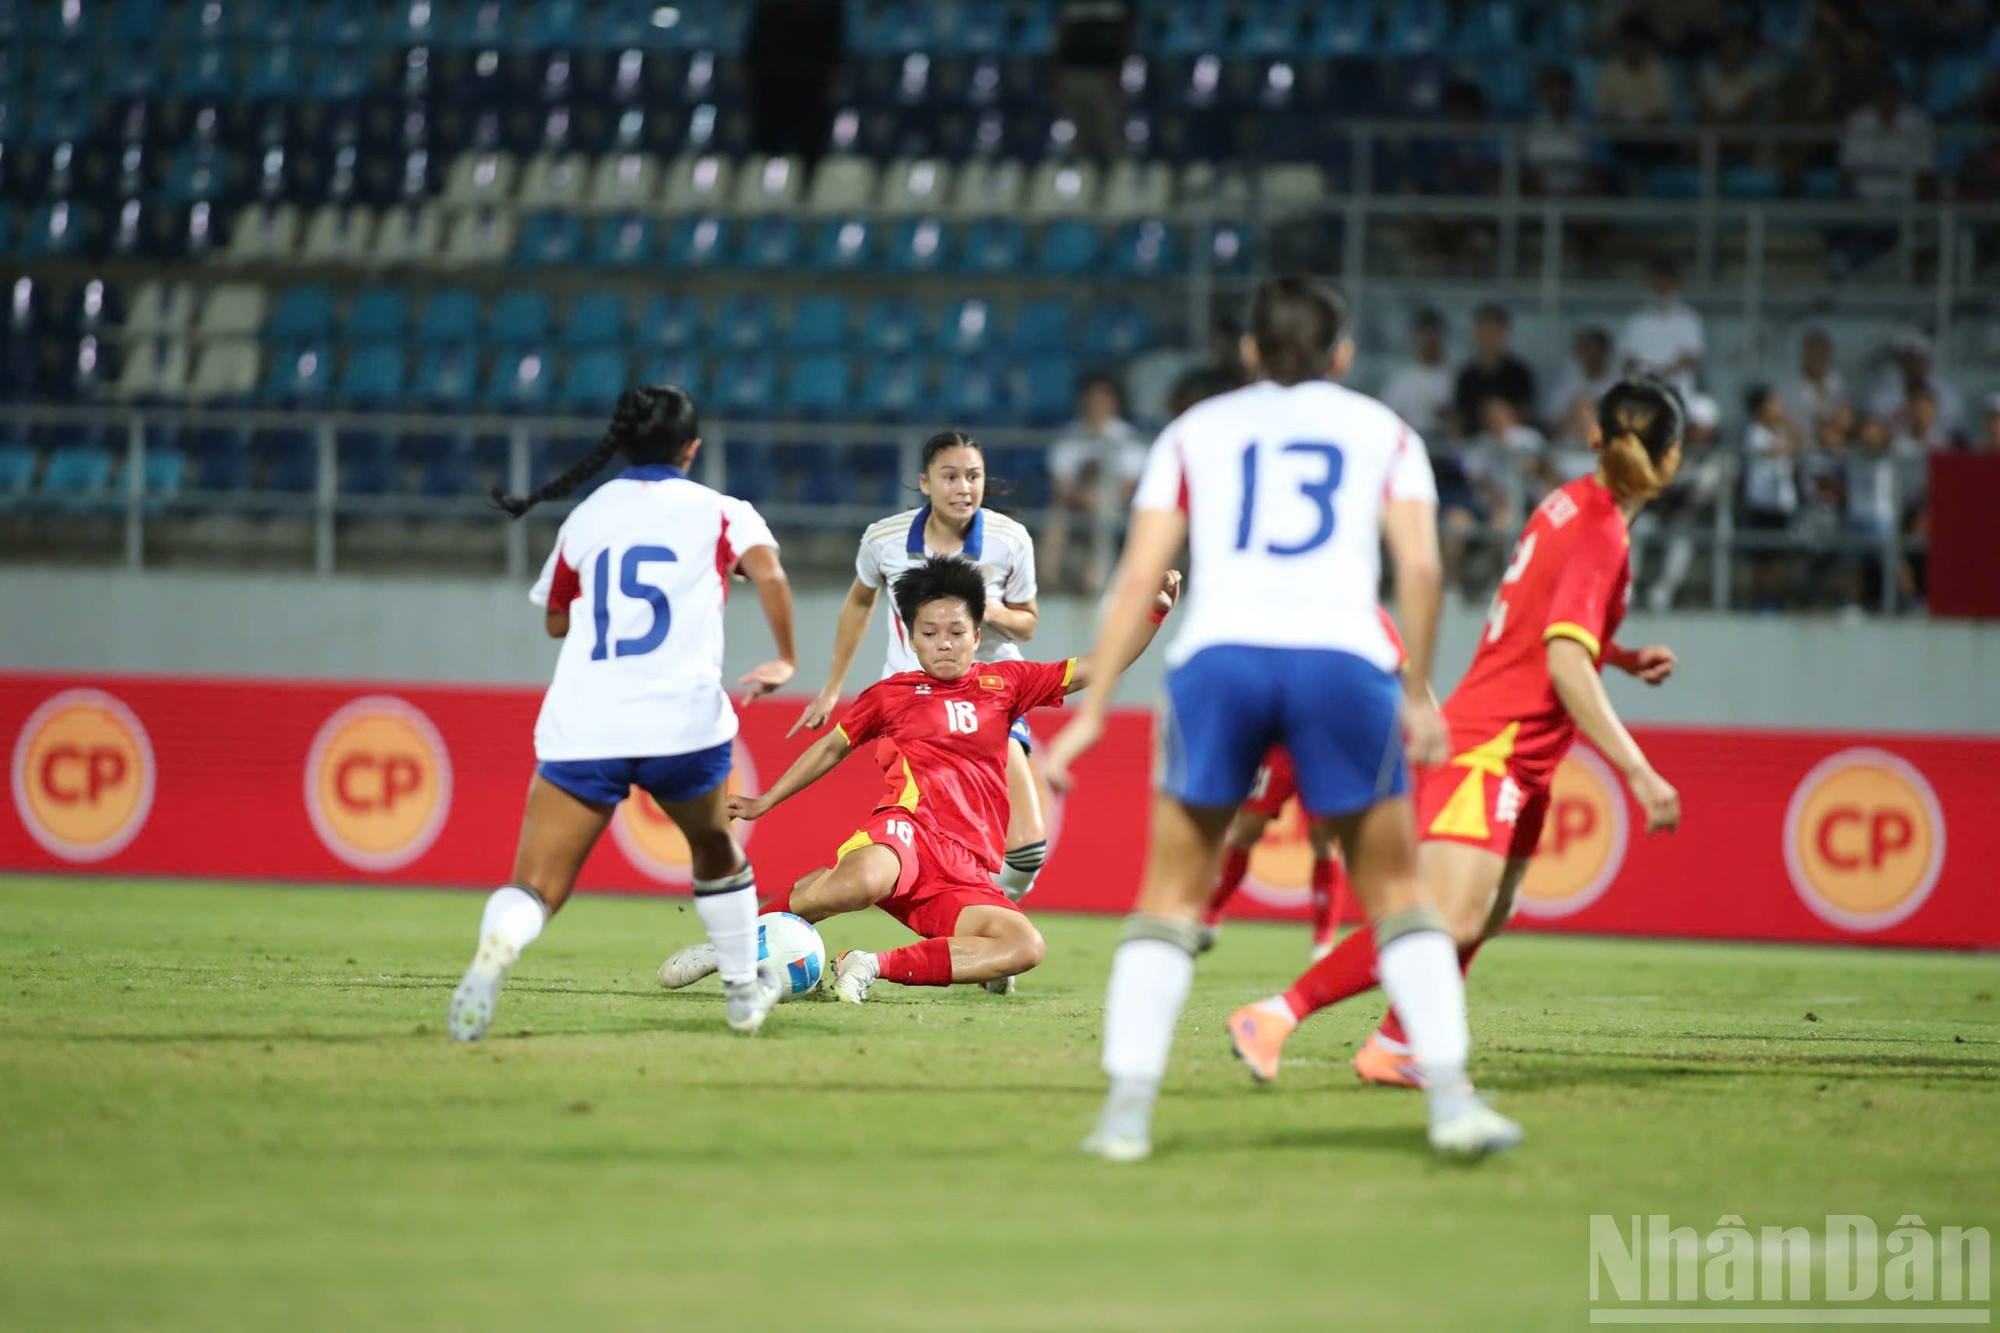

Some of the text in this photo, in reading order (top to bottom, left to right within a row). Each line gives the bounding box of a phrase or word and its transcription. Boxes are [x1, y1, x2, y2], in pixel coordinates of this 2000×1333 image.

[1234, 441, 1344, 556] 13
[591, 545, 678, 661] 15
[944, 700, 978, 734] 18
[40, 744, 126, 806] CP
[334, 752, 424, 814] CP
[886, 819, 914, 848] 18
[1816, 807, 1914, 871] CP
